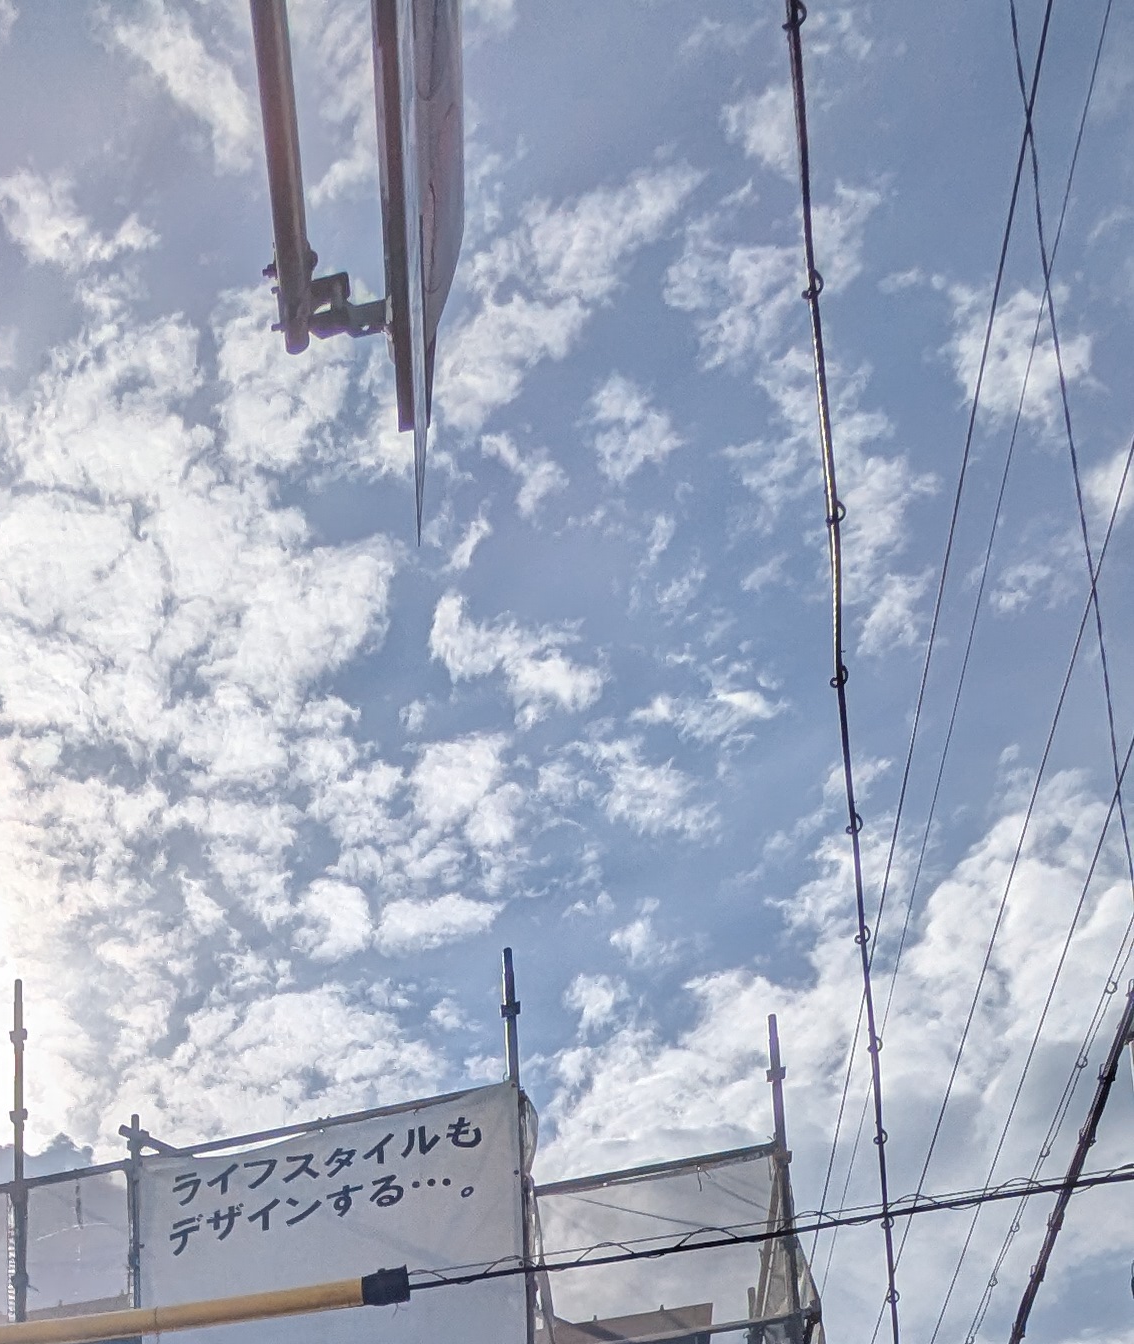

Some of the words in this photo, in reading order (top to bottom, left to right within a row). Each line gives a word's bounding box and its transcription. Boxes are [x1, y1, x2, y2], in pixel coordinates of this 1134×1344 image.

[171, 1116, 483, 1207] ライフスタイルも
